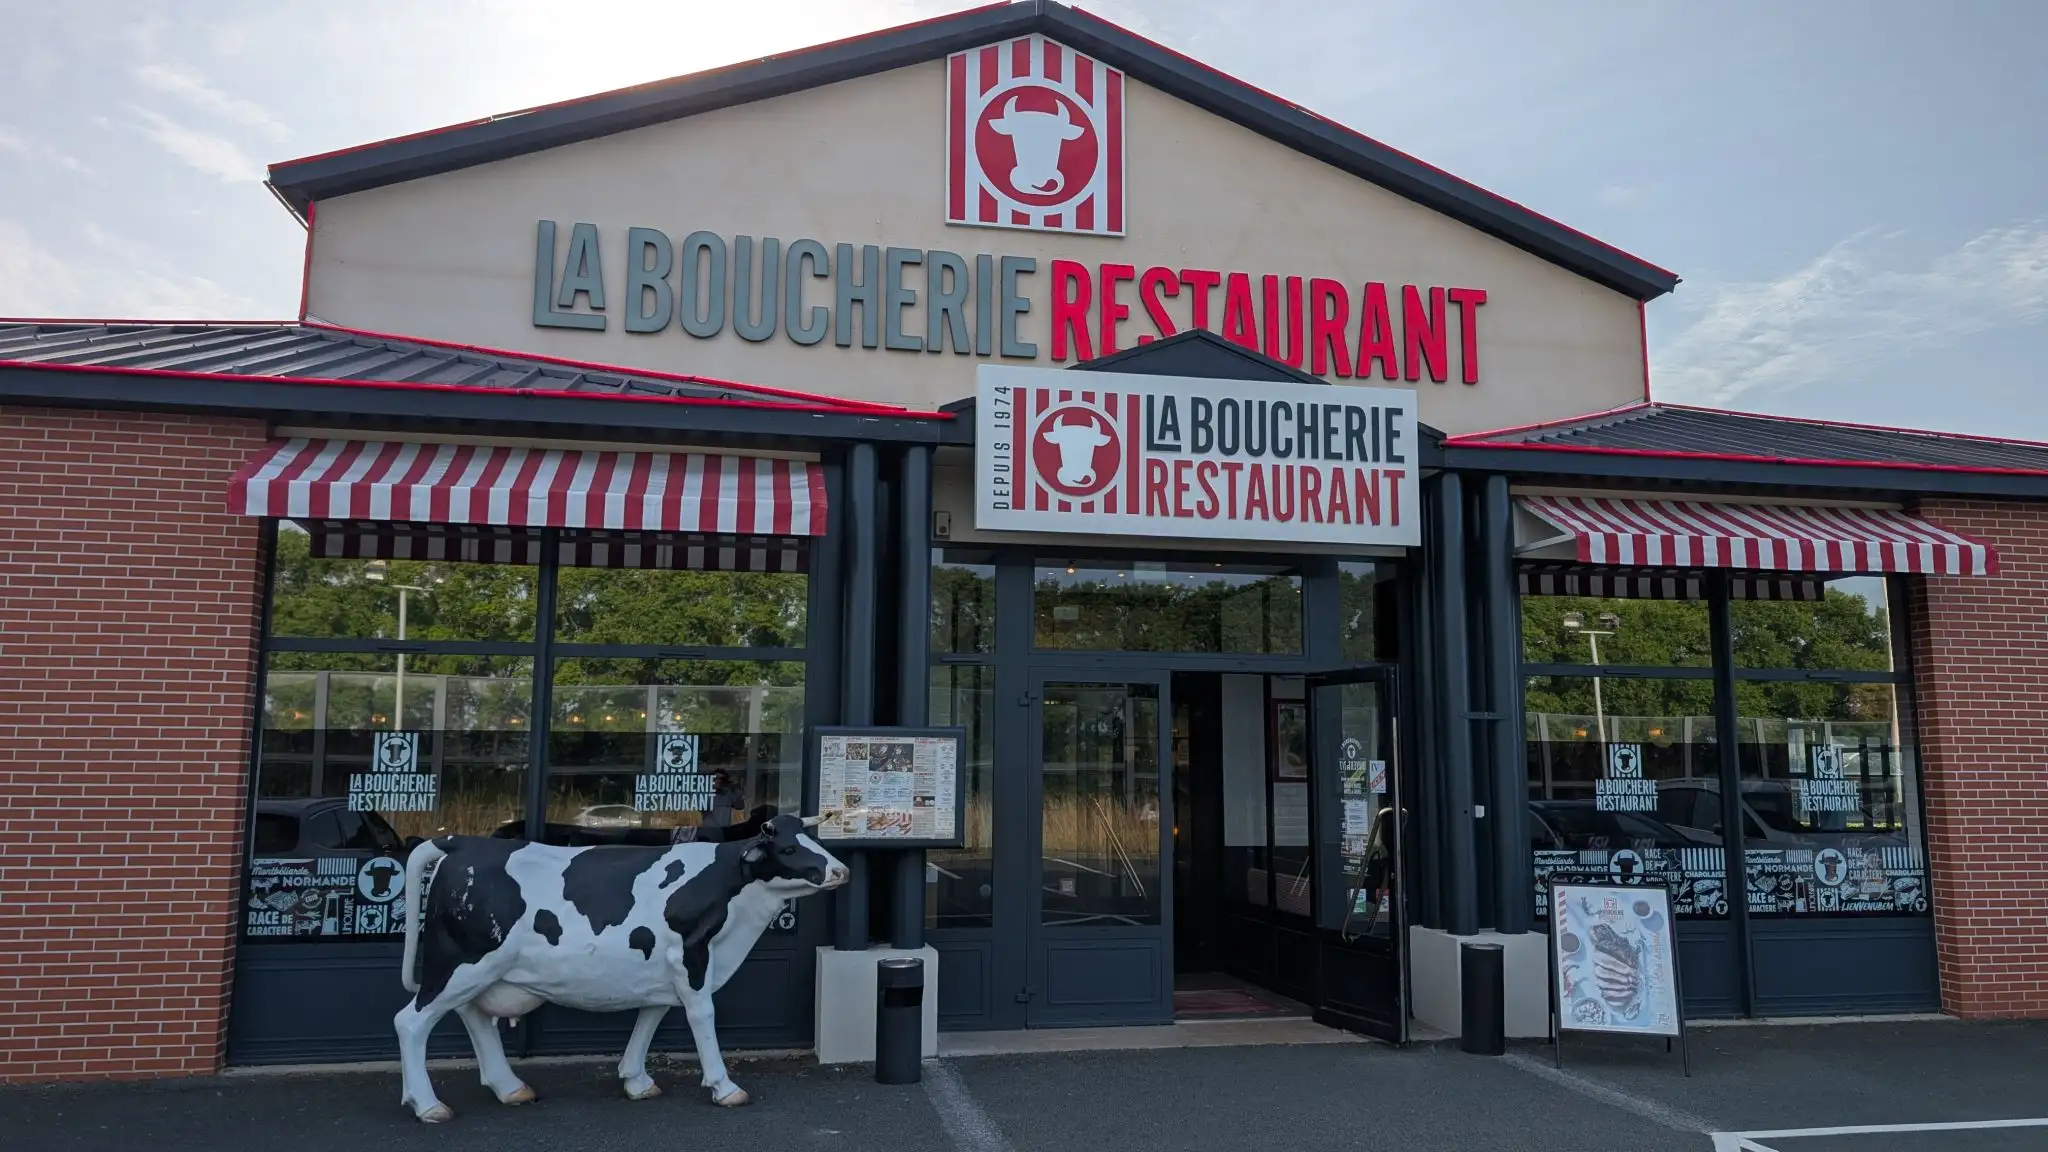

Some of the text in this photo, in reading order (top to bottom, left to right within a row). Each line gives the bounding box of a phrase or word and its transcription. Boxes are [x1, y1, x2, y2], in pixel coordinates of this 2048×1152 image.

[533, 220, 1487, 384] LA BOUCHERIE RESTAURANT
[1146, 394, 1405, 464] LA BOUCHERIE
[993, 386, 1011, 510] DEPUIS 1974
[1146, 458, 1405, 526] RESTAURANT
[349, 774, 436, 793] LA BOUCHERIE
[635, 775, 717, 793] LA BOUCHERIE
[1596, 779, 1658, 795] LA BOUCHERIE
[1800, 780, 1859, 796] LA BOUCHERIE
[348, 793, 436, 812] RESTAURANT
[635, 794, 716, 812] RESTAURANT
[1596, 796, 1658, 811] RESTAURANT
[1801, 796, 1860, 812] RESTAURANT
[1645, 849, 1661, 859] RACE
[1645, 861, 1653, 870] DE
[1765, 865, 1814, 873] NORMANDE
[283, 876, 355, 886] NORMANDE
[1536, 895, 1547, 906] RA
[1748, 904, 1776, 912] ARACTERE
[248, 911, 293, 925] RACE DE
